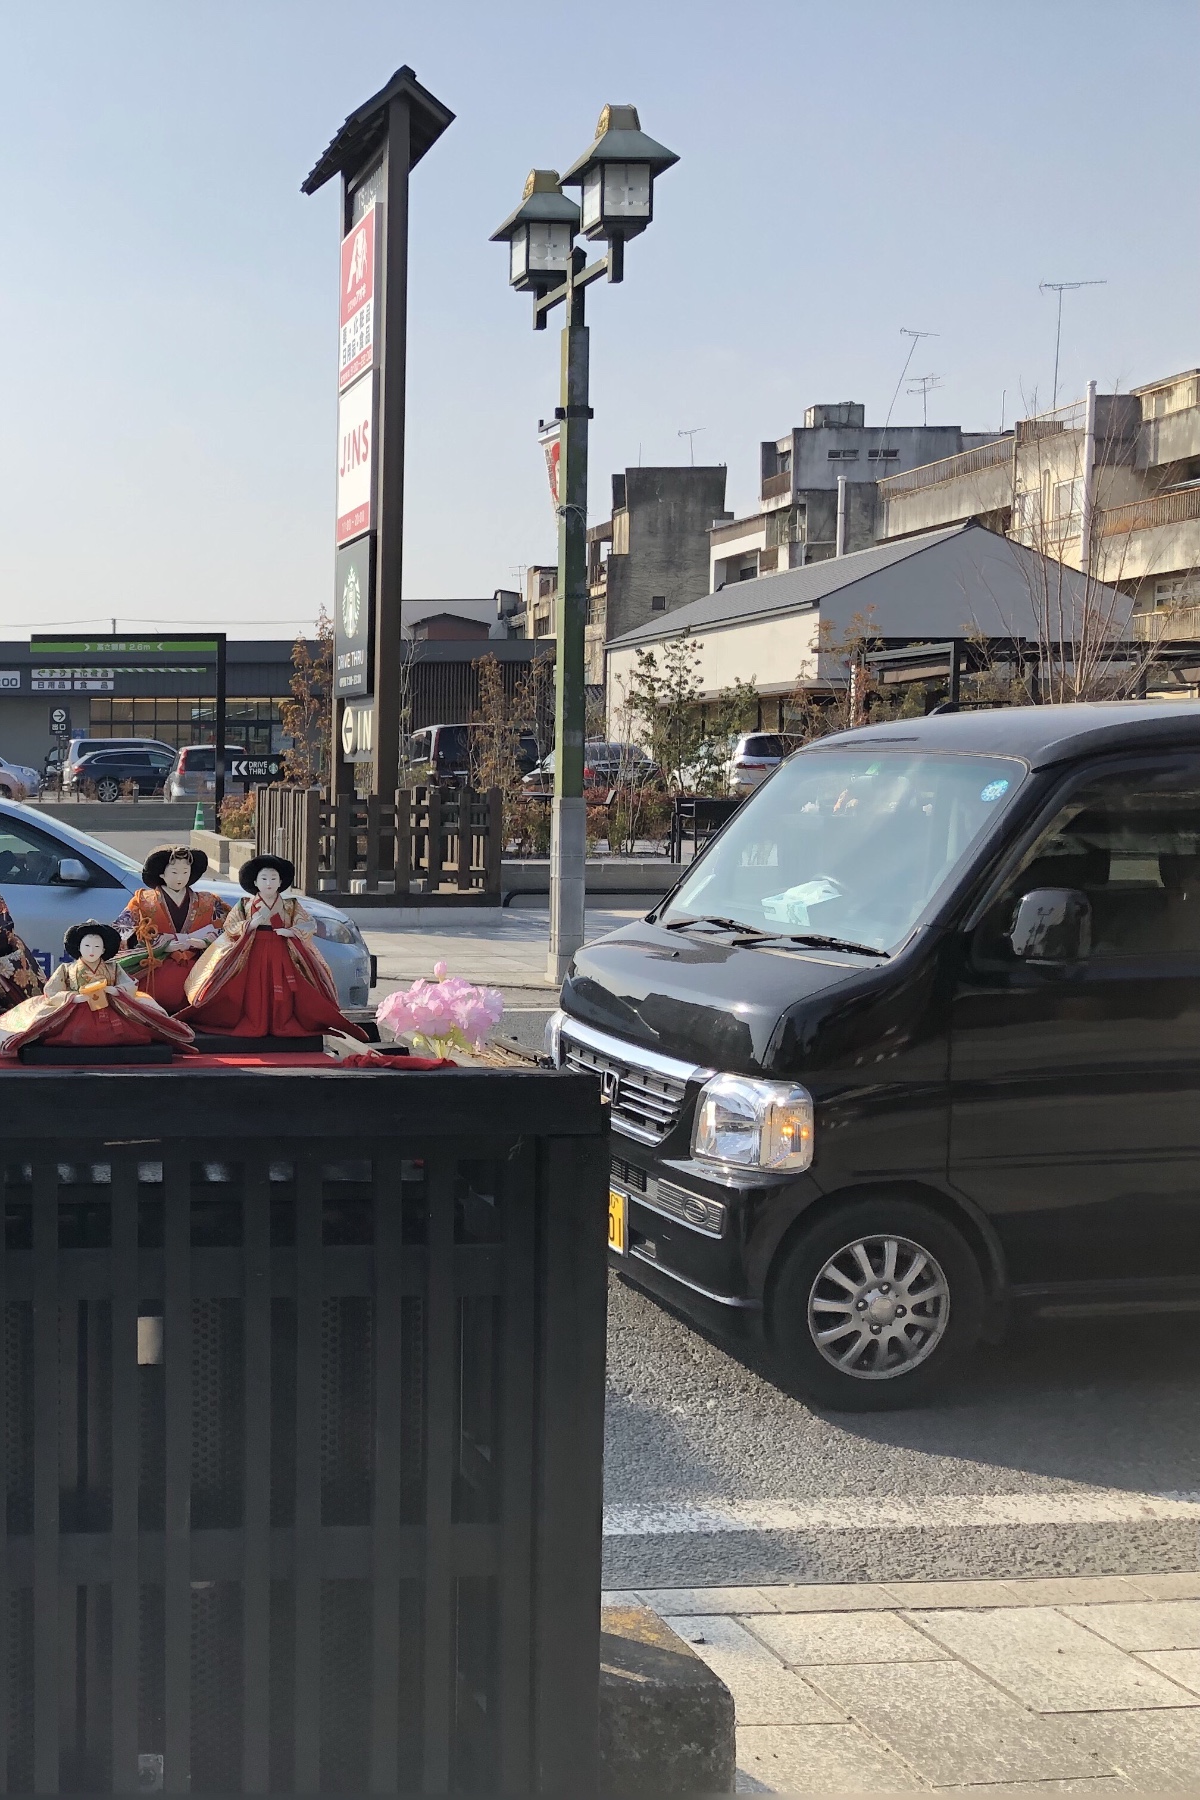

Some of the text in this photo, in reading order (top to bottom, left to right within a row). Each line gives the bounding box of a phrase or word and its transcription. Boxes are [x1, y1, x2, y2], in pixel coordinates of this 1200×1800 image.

[337, 649, 364, 670] DRIVE THRU
[37, 681, 66, 689] 日用品
[51, 723, 66, 731] 出口
[357, 710, 372, 751] IN
